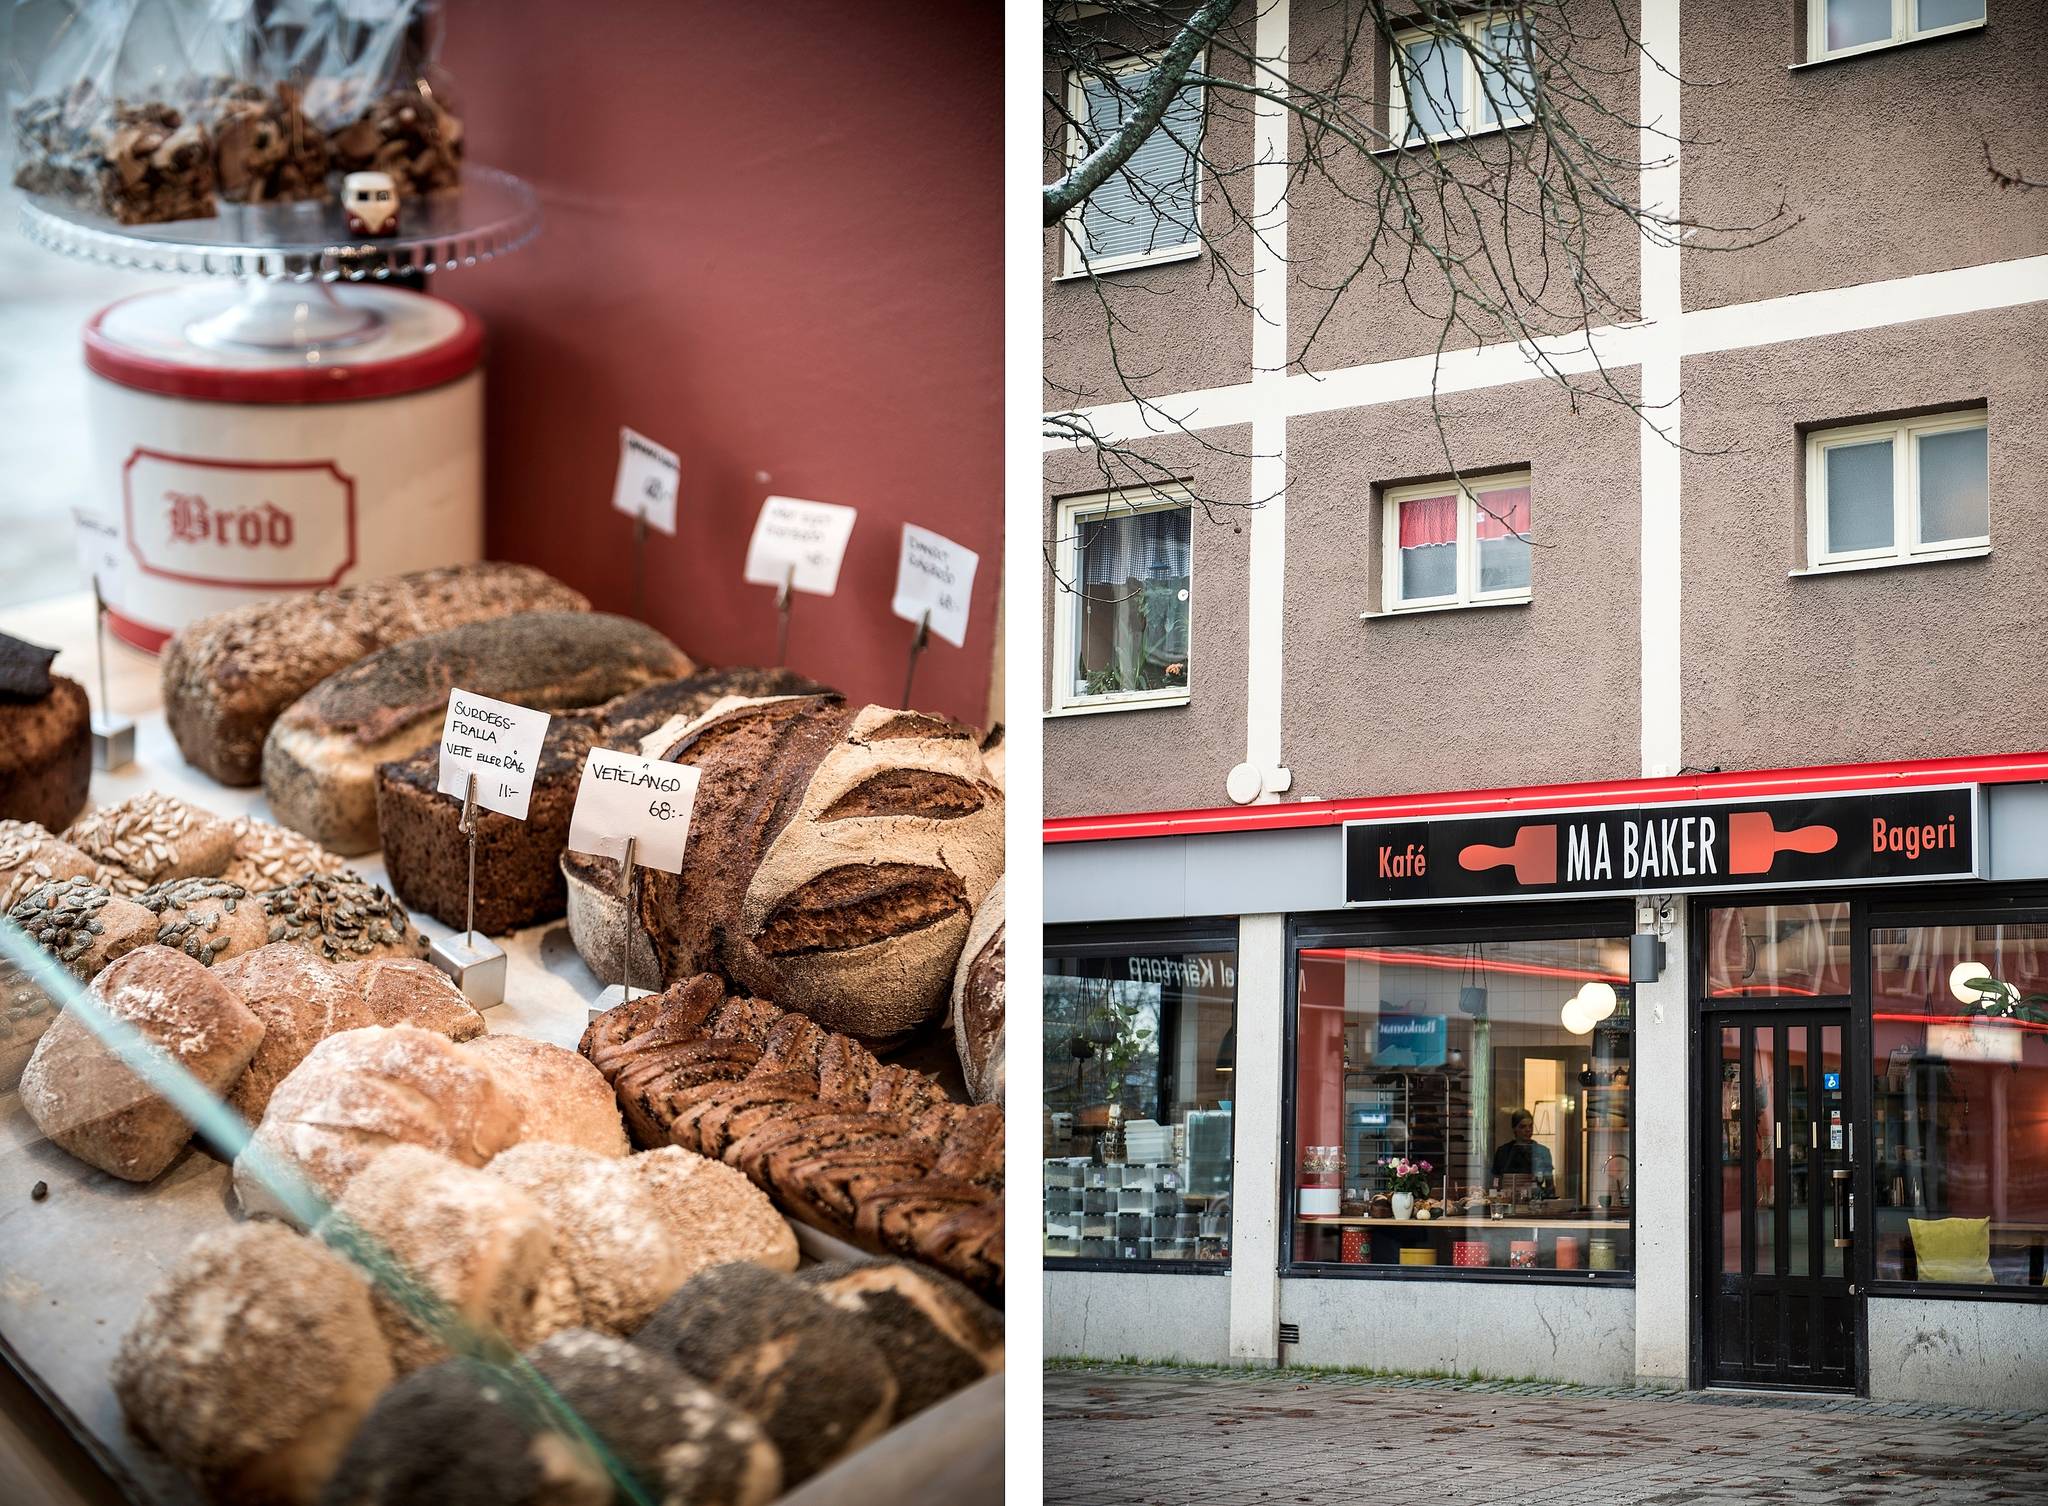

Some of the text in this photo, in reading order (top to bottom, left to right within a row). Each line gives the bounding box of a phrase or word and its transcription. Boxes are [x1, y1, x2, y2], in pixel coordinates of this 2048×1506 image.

[454, 701, 516, 730] SURDEGS-
[452, 720, 497, 744] FRALLA
[446, 742, 525, 773] VETE ELLER RÅG
[649, 800, 684, 820] 68:-
[1566, 815, 1718, 882] MA BAKER
[1872, 814, 1957, 860] Bageri
[1379, 843, 1427, 878] Kafé
